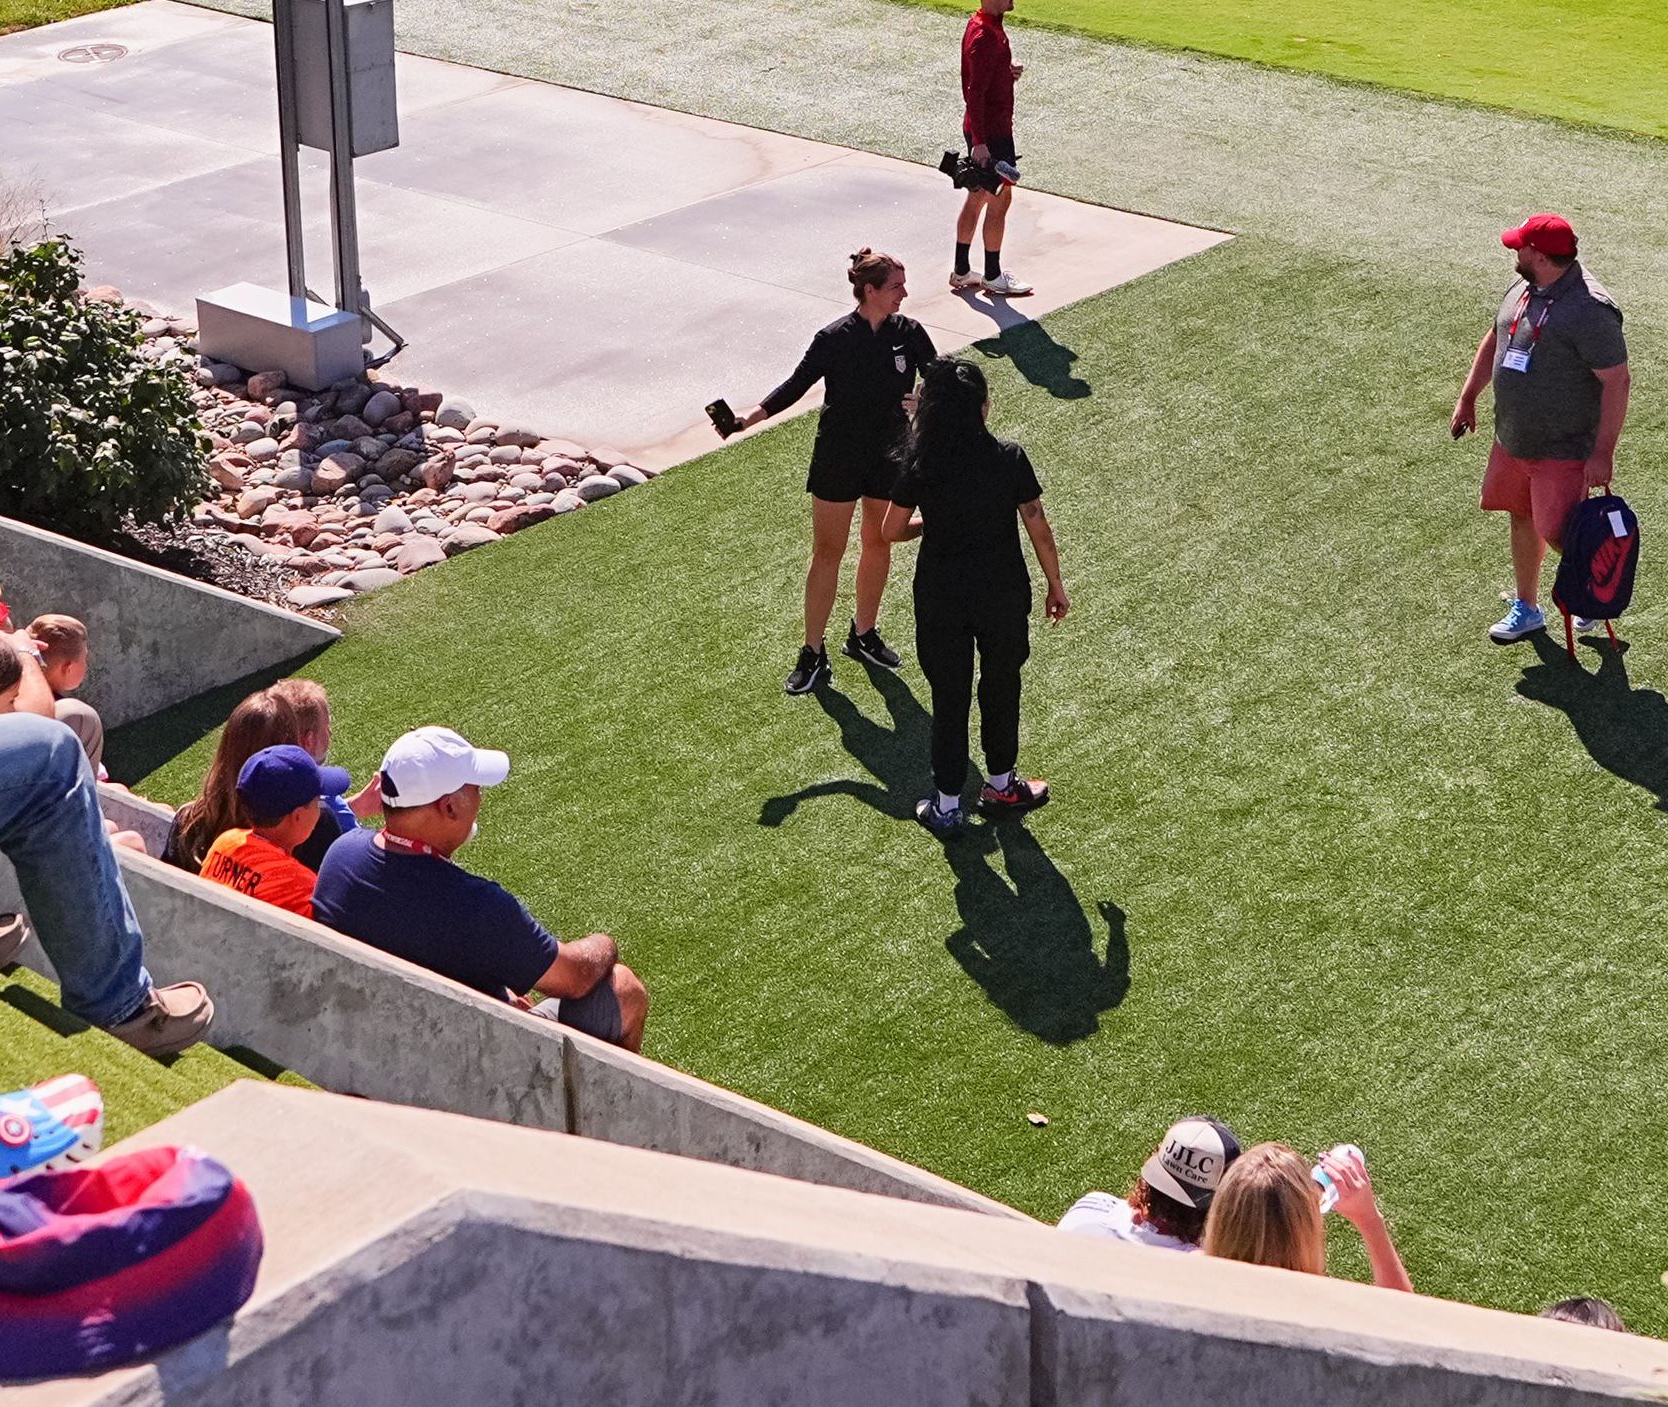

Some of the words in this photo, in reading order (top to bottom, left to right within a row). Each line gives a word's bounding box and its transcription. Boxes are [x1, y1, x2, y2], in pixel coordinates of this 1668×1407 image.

[206, 850, 262, 897] TURNER
[1165, 1139, 1214, 1174] JJLC
[1184, 1169, 1208, 1183] Care
